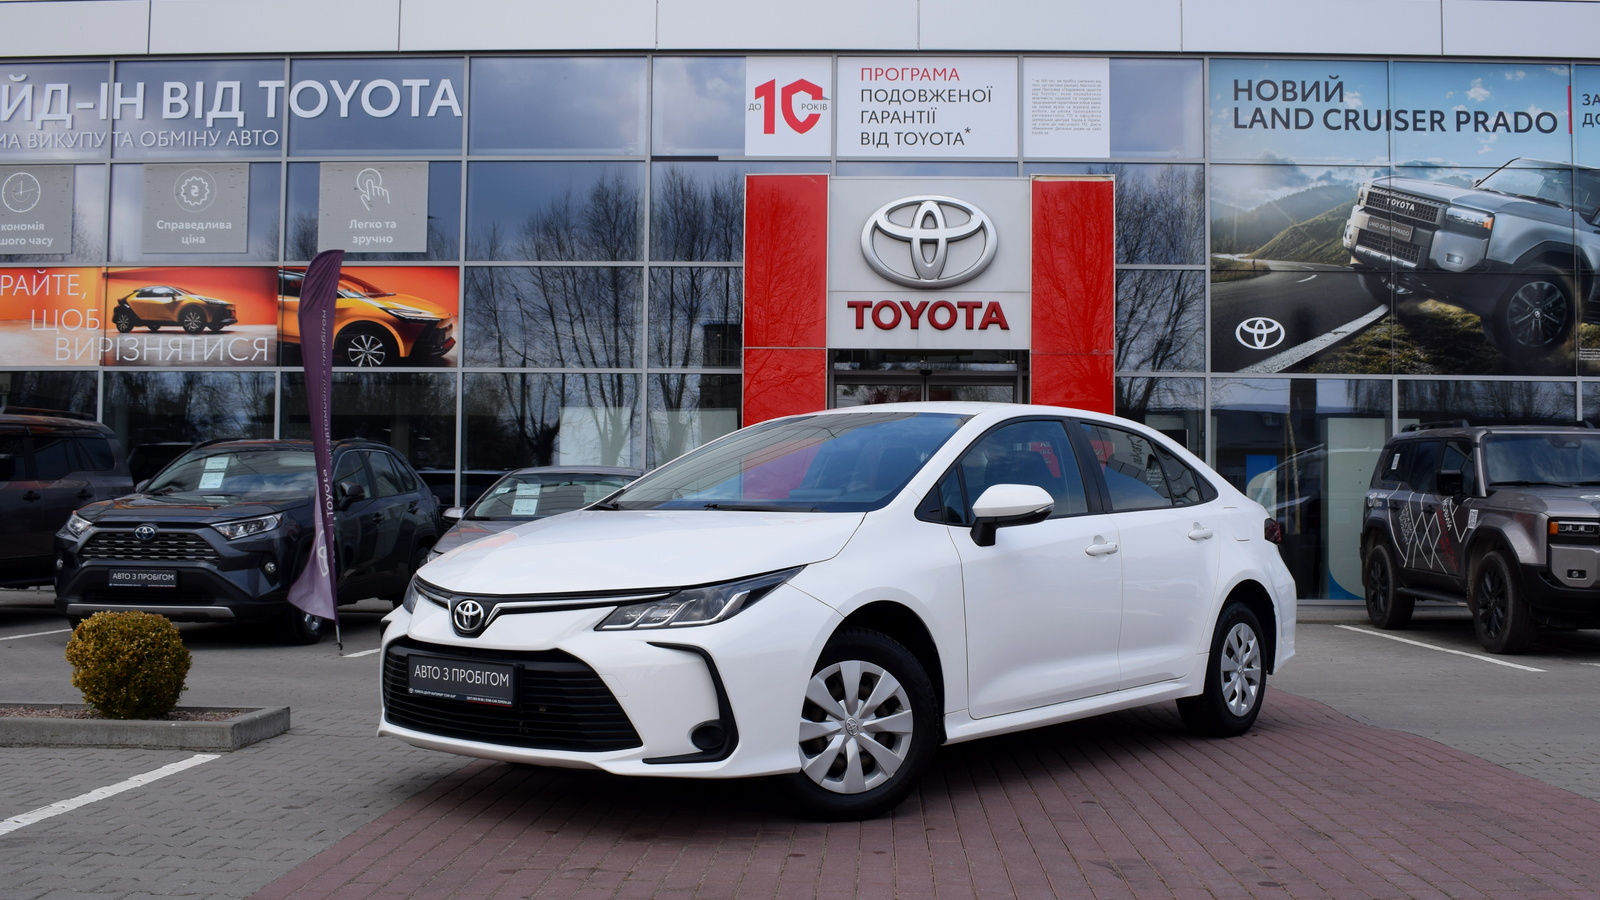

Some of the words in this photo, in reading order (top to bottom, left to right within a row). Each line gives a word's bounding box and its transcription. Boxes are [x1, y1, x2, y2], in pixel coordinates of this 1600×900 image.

[860, 67, 961, 81] ПРОГРАМА
[860, 86, 994, 105] ПОДОВЖЕНОЇ
[1233, 75, 1344, 103] НОВИЙ
[1, 73, 145, 130] ЙД-ІН
[162, 80, 245, 128] ВІД
[258, 79, 463, 118] TOYOTA
[748, 103, 762, 111] ДО
[801, 103, 828, 111] РОКІВ
[860, 107, 938, 124] ГАРАНТІЇ
[1233, 107, 1315, 130] LAND
[1322, 108, 1446, 132] CRUISER
[1455, 110, 1558, 134] PRADO
[27, 132, 107, 148] ВИКУПУ
[112, 131, 134, 148] ТА
[140, 129, 222, 148] ОБМІНУ
[225, 129, 279, 147] АВТО
[860, 131, 890, 148] ВІД
[1386, 198, 1415, 212] TOYOTA
[1, 221, 45, 231] кономія
[156, 219, 232, 232] Справедлива
[349, 219, 382, 229] Легко
[385, 220, 397, 229] та
[29, 237, 54, 247] часу
[181, 233, 206, 246] ціна
[352, 235, 394, 246] зручно
[0, 269, 87, 299] РАЙТЕ,
[31, 308, 101, 335] ЩОБ
[847, 300, 1010, 331] TOYOTA
[55, 336, 268, 361] ВИРІЗНЯТИСЯ
[322, 469, 334, 518] Toyota
[112, 572, 131, 580] АВТО
[138, 573, 175, 581] ПРОБІГОМ
[414, 664, 440, 680] АВТО
[442, 667, 450, 681] З
[451, 668, 509, 687] ПРОБІГОМ
